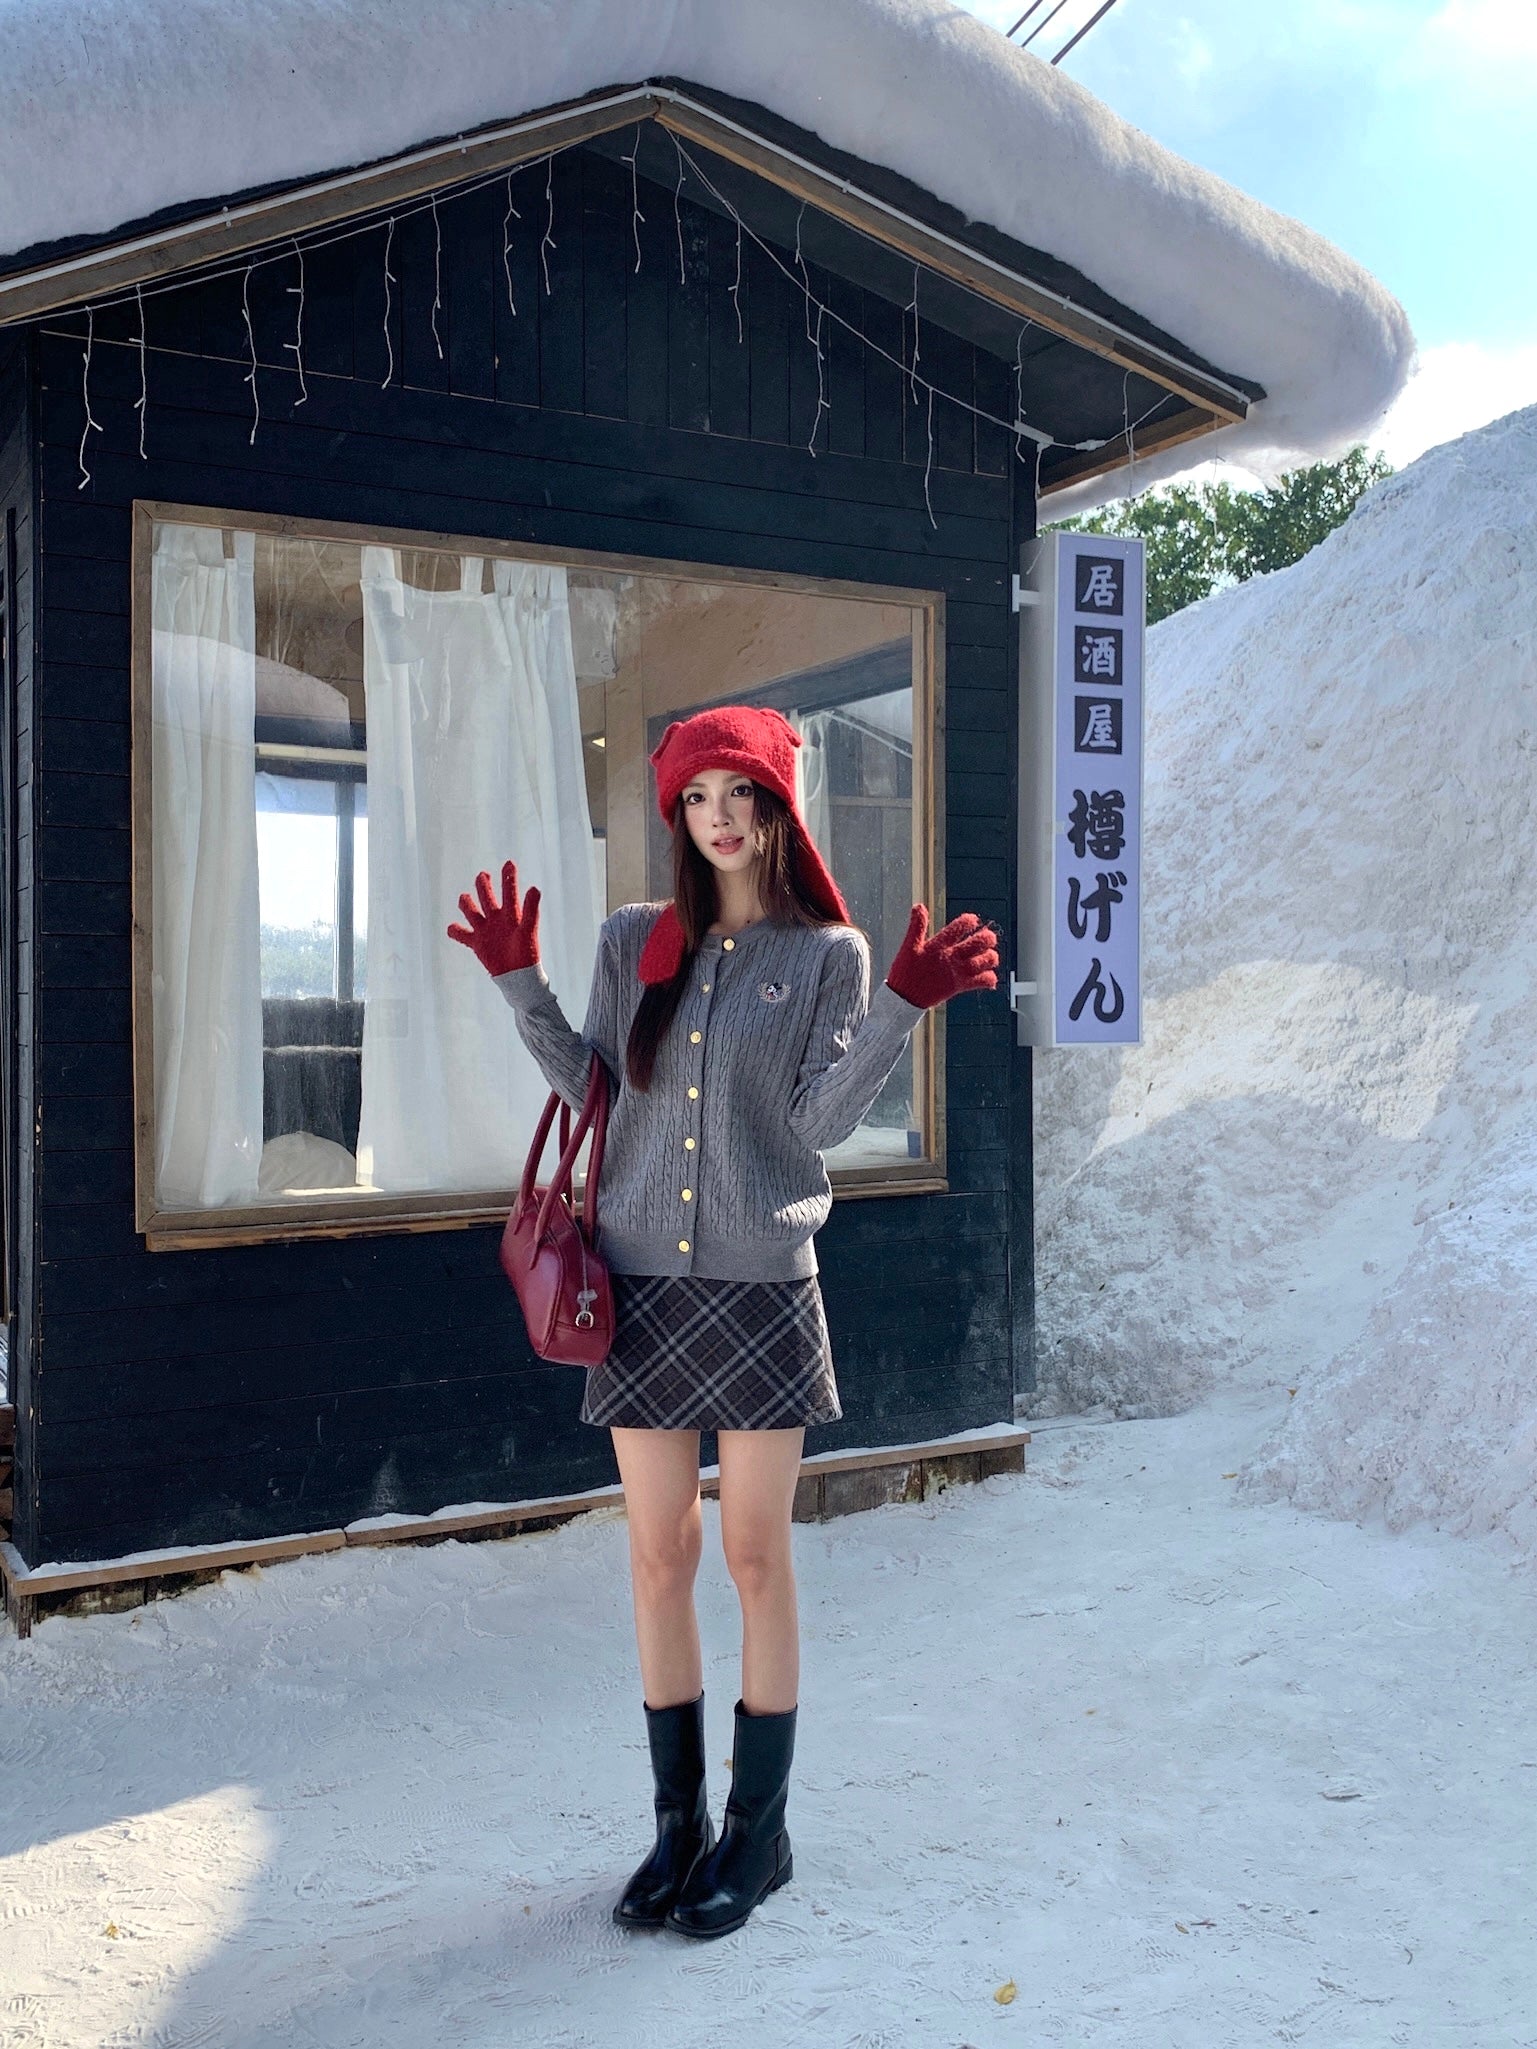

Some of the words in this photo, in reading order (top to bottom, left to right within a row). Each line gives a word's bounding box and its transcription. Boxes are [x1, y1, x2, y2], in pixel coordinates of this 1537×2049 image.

[1080, 564, 1118, 749] 居酒屋
[1067, 789, 1127, 1023] 樽げん
